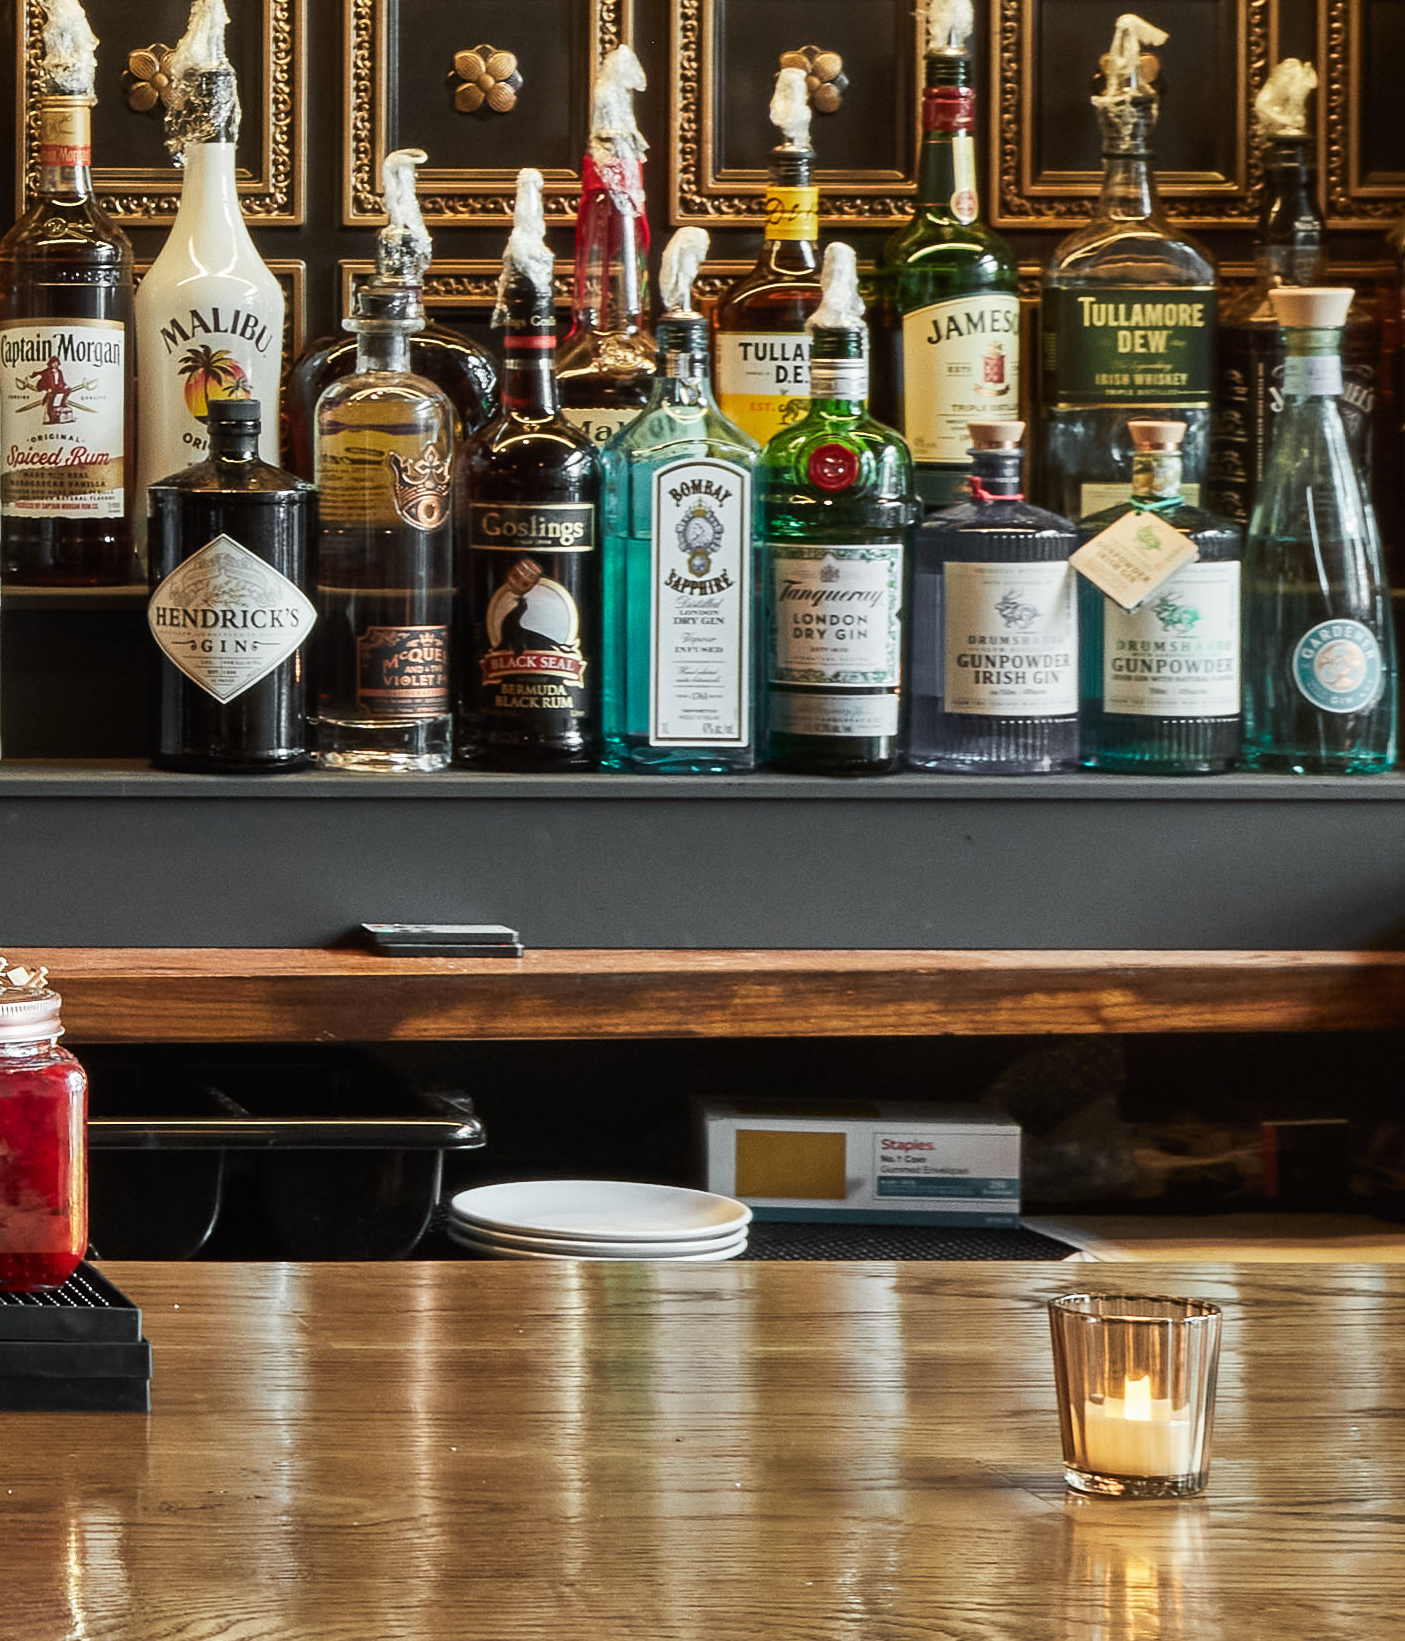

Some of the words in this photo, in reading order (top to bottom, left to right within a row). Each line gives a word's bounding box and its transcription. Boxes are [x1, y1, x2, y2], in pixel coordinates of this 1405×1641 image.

[1078, 296, 1206, 327] TULLAMORE
[160, 308, 273, 354] MALIBU
[927, 309, 1019, 345] JAMES
[1117, 330, 1169, 353] DEW
[0, 334, 52, 368] Captain
[53, 333, 121, 367] Morgan
[738, 343, 813, 361] TULLA
[1095, 373, 1129, 385] IRISH
[1134, 373, 1189, 385] WHISKEY
[7, 445, 64, 467] Spiced
[65, 445, 110, 467] Rum
[669, 479, 733, 505] BOMBAY
[482, 512, 584, 546] Goslings
[664, 570, 734, 596] SAPPHIRE
[779, 580, 885, 608] Tanqueray
[156, 606, 299, 629] HENDRICK'S
[673, 617, 697, 625] DRY
[701, 617, 725, 625] GIN
[793, 614, 868, 625] LONDON
[793, 628, 827, 640] DRY
[835, 629, 868, 640] GIN
[201, 640, 247, 653] GIN
[491, 656, 537, 670] BLACK
[540, 656, 574, 671] SEAL
[956, 653, 1070, 669] GUNPOWDER
[1112, 658, 1234, 674] GUNPOWDER
[383, 675, 435, 686] VIOLET
[974, 670, 1027, 685] IRISH
[1033, 671, 1062, 685] GIN
[501, 684, 567, 696] BERMUDA
[495, 697, 540, 708] BLACK
[542, 697, 574, 709] RUM
